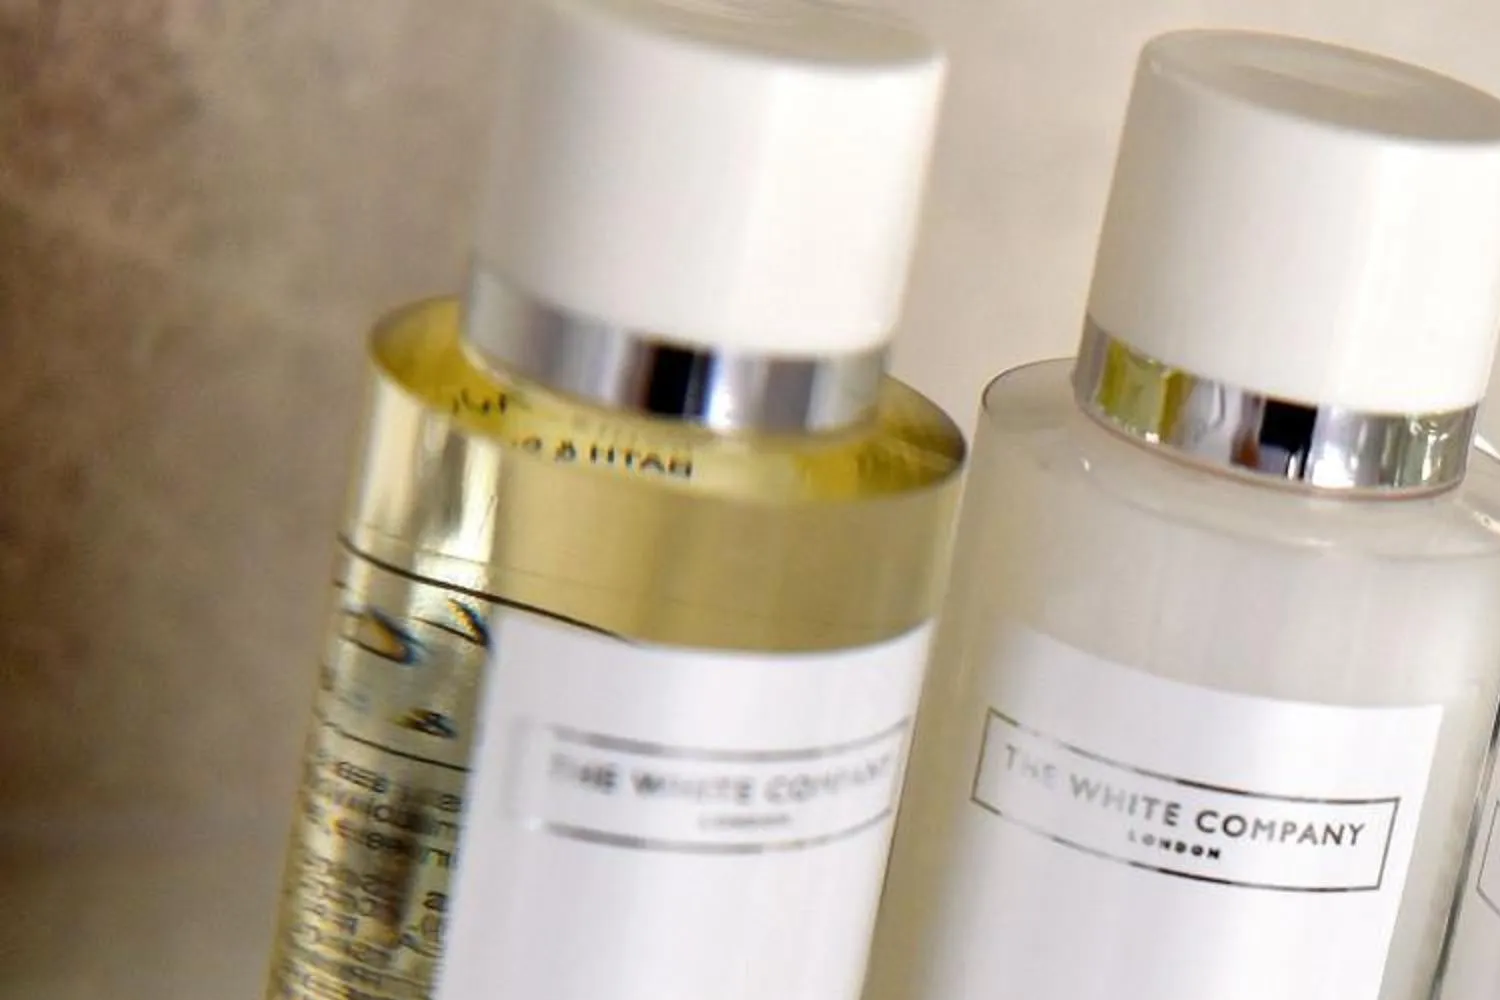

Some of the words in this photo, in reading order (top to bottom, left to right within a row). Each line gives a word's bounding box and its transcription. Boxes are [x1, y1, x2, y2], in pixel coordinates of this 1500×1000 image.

[1003, 743, 1056, 788] THE
[1070, 773, 1181, 828] WHITE
[1195, 809, 1366, 847] COMPANY
[1127, 828, 1222, 861] LONDON
